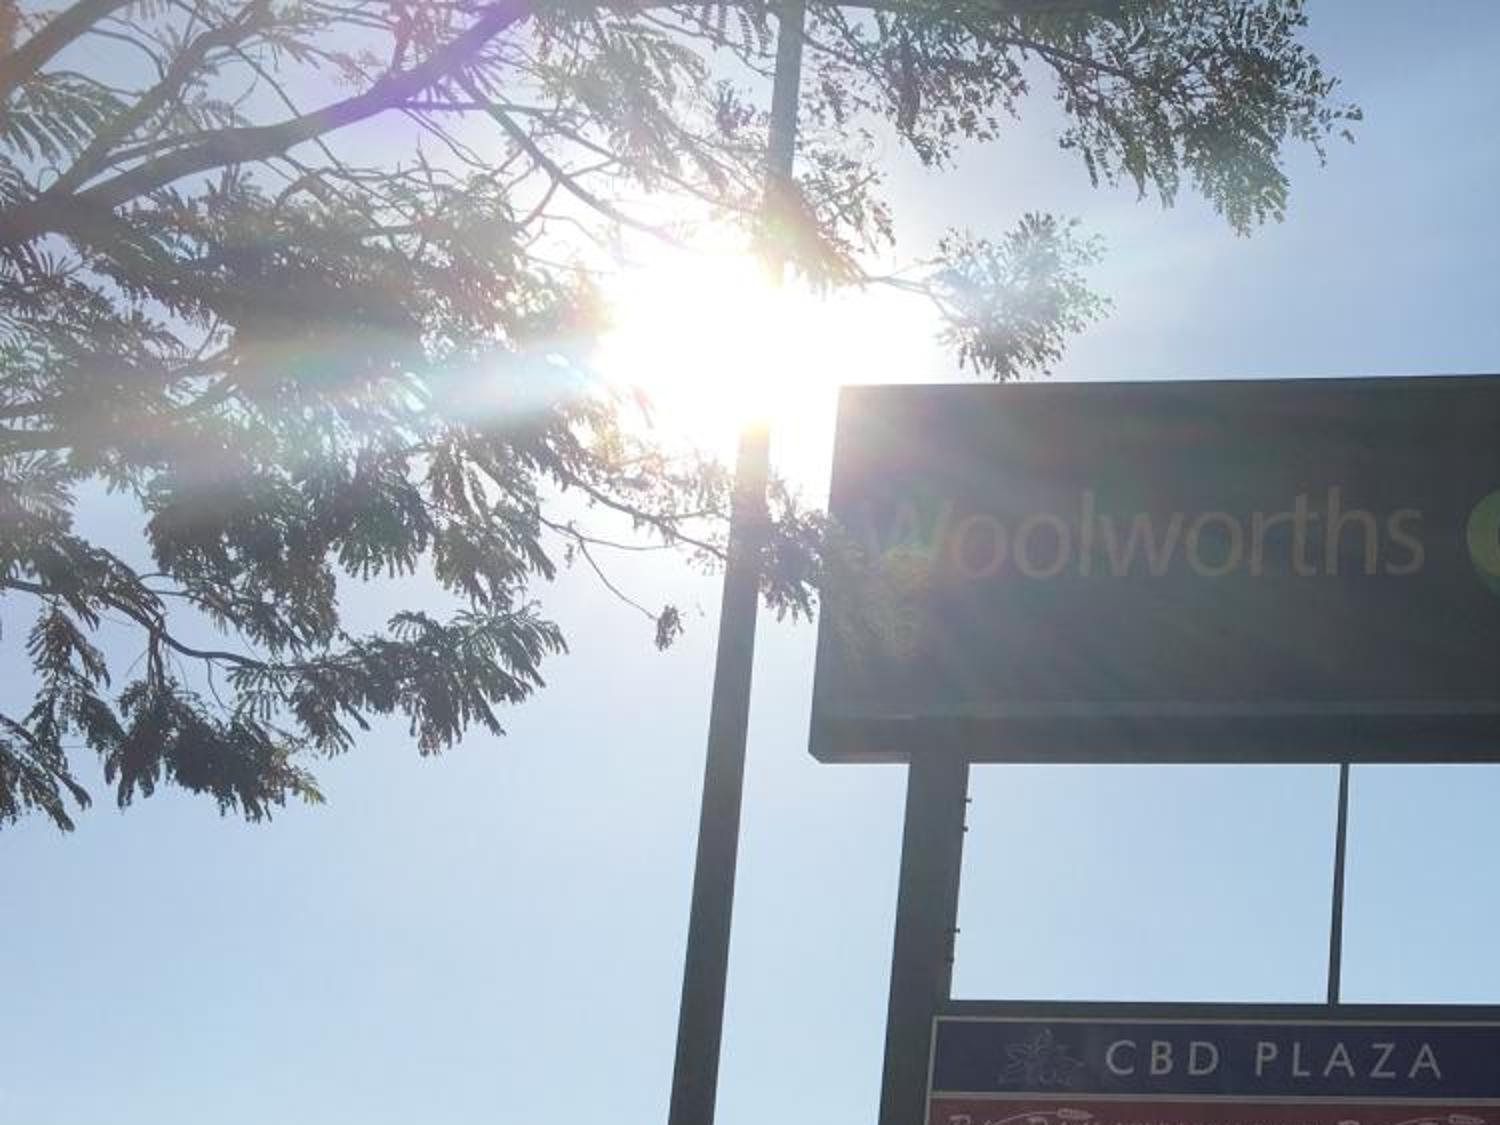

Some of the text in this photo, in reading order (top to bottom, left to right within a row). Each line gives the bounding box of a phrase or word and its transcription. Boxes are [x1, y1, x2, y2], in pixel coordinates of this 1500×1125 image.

[866, 486, 1425, 580] Woolworths
[1105, 1039, 1443, 1081] CBD PLAZA
